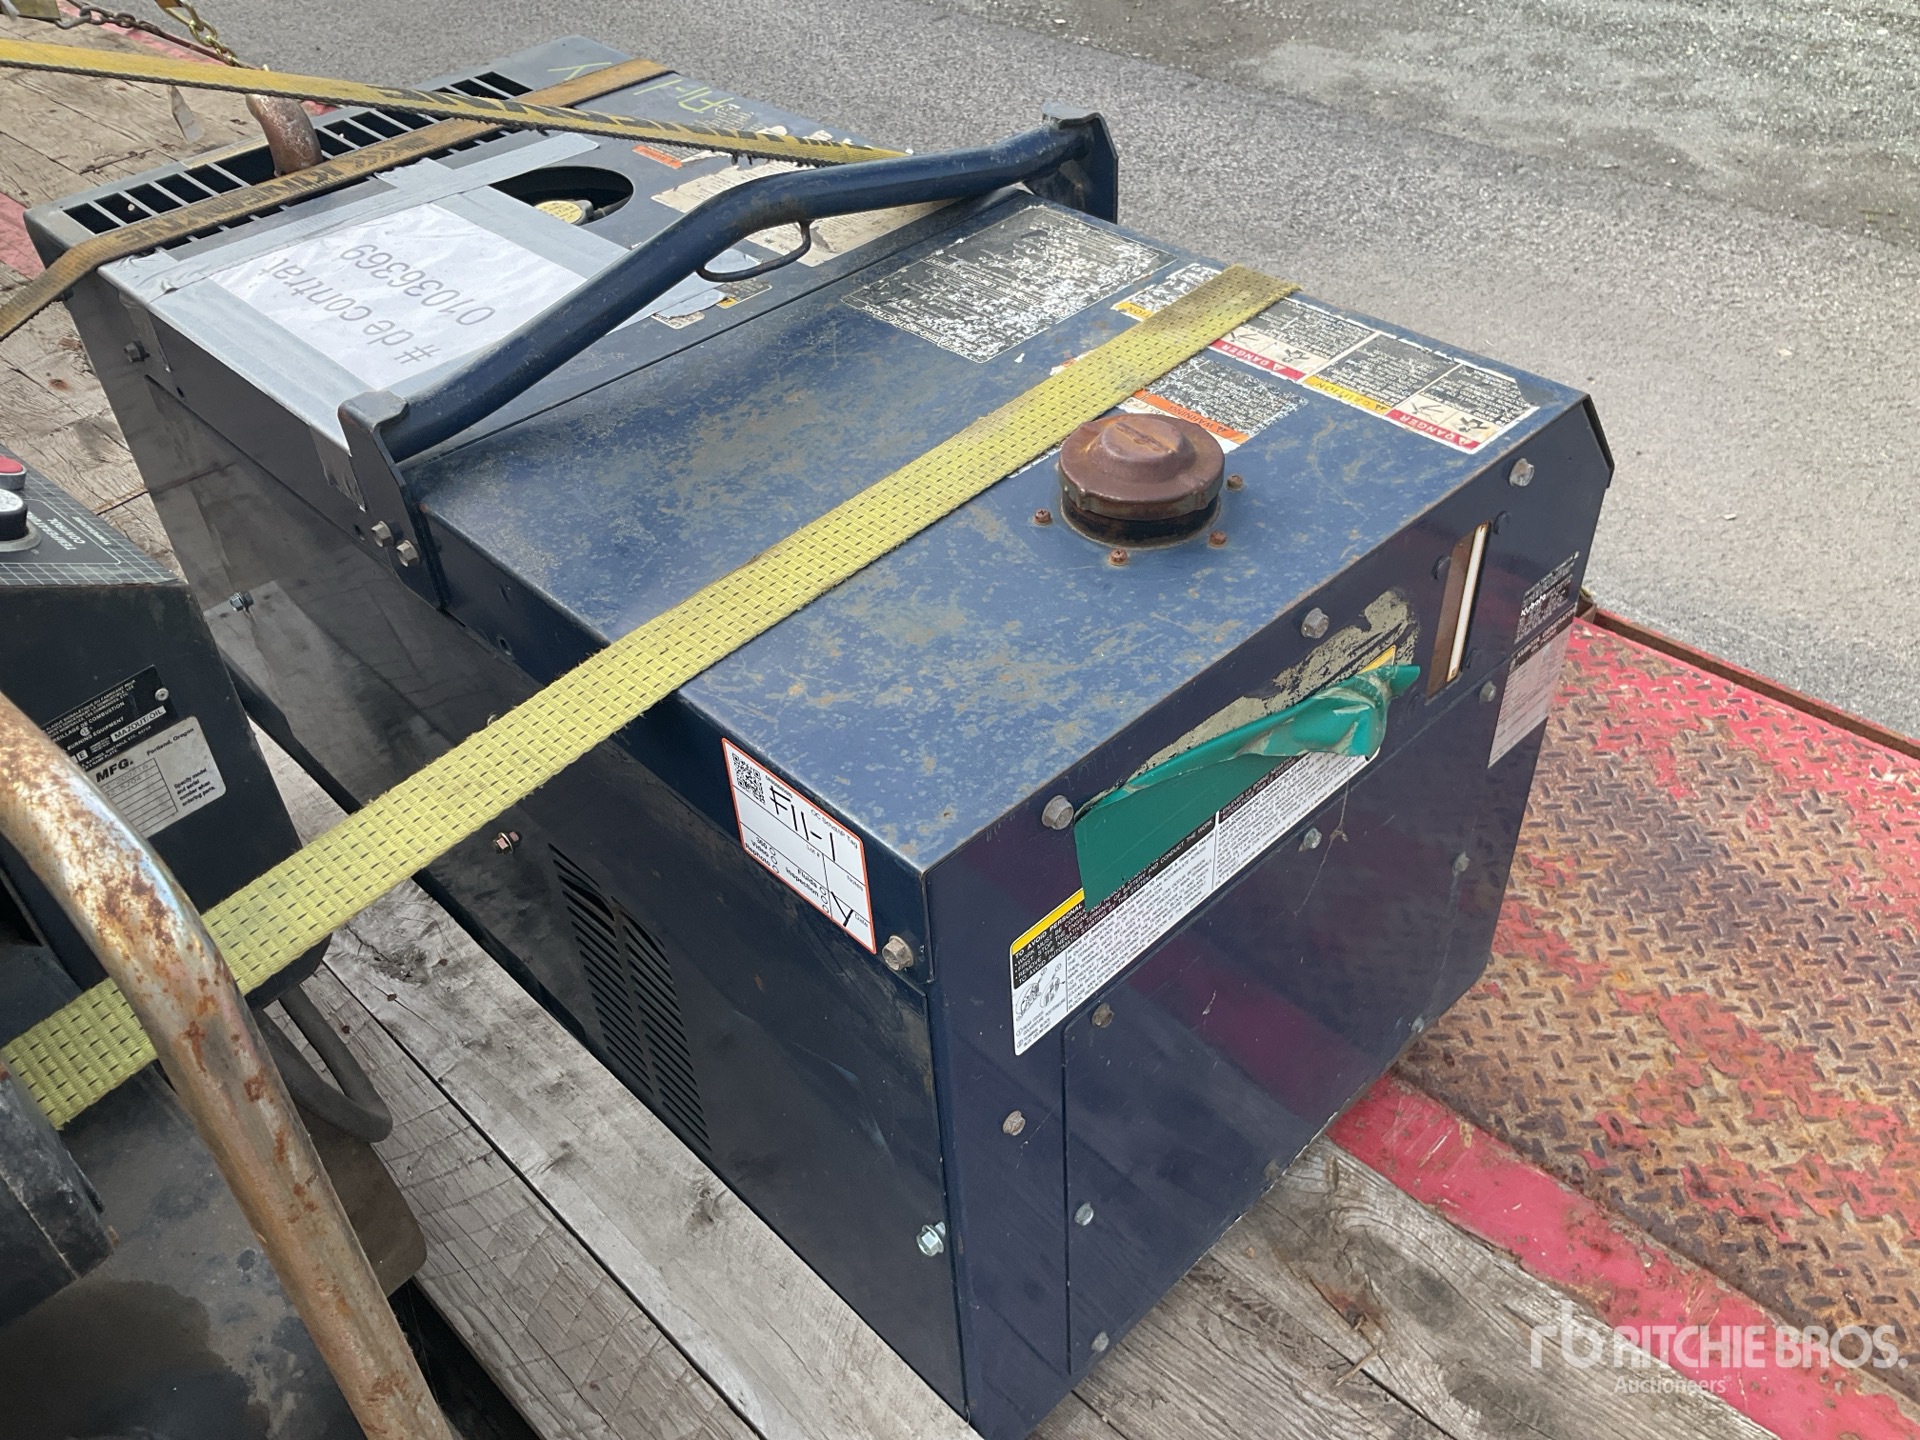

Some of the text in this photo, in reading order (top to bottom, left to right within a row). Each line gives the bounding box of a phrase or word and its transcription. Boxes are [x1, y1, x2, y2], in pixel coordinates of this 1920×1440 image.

[257, 257, 371, 322] contrat
[337, 243, 496, 326] 01036369
[363, 319, 414, 350] de
[1219, 344, 1272, 365] DANGER
[1314, 382, 1372, 406] CAUTION
[1165, 405, 1216, 428] WARNING
[1397, 413, 1457, 440] DANGER
[96, 728, 194, 782] MFG. Portland, Oregon
[174, 768, 207, 789] Specify model
[179, 789, 198, 800] number
[750, 840, 769, 858] Video
[786, 867, 819, 897] Inspection
[798, 868, 817, 888] Fluids
[1018, 957, 1041, 978] REMOVE
[1057, 923, 1083, 946] NEGATIVE
[1086, 901, 1110, 923] TERMINAL
[1160, 842, 1183, 864] CONDUCT
[1197, 819, 1212, 834] WORK
[1027, 931, 1046, 949] AVOID
[1049, 903, 1082, 931] PERSONAL
[1028, 959, 1046, 976] AVOID
[1048, 933, 1078, 960] AUTOMATIC
[1081, 910, 1106, 934] STARTING
[1130, 874, 1150, 894] SYSTEM
[1017, 949, 1034, 965] WORK
[1036, 935, 1051, 949] MUST
